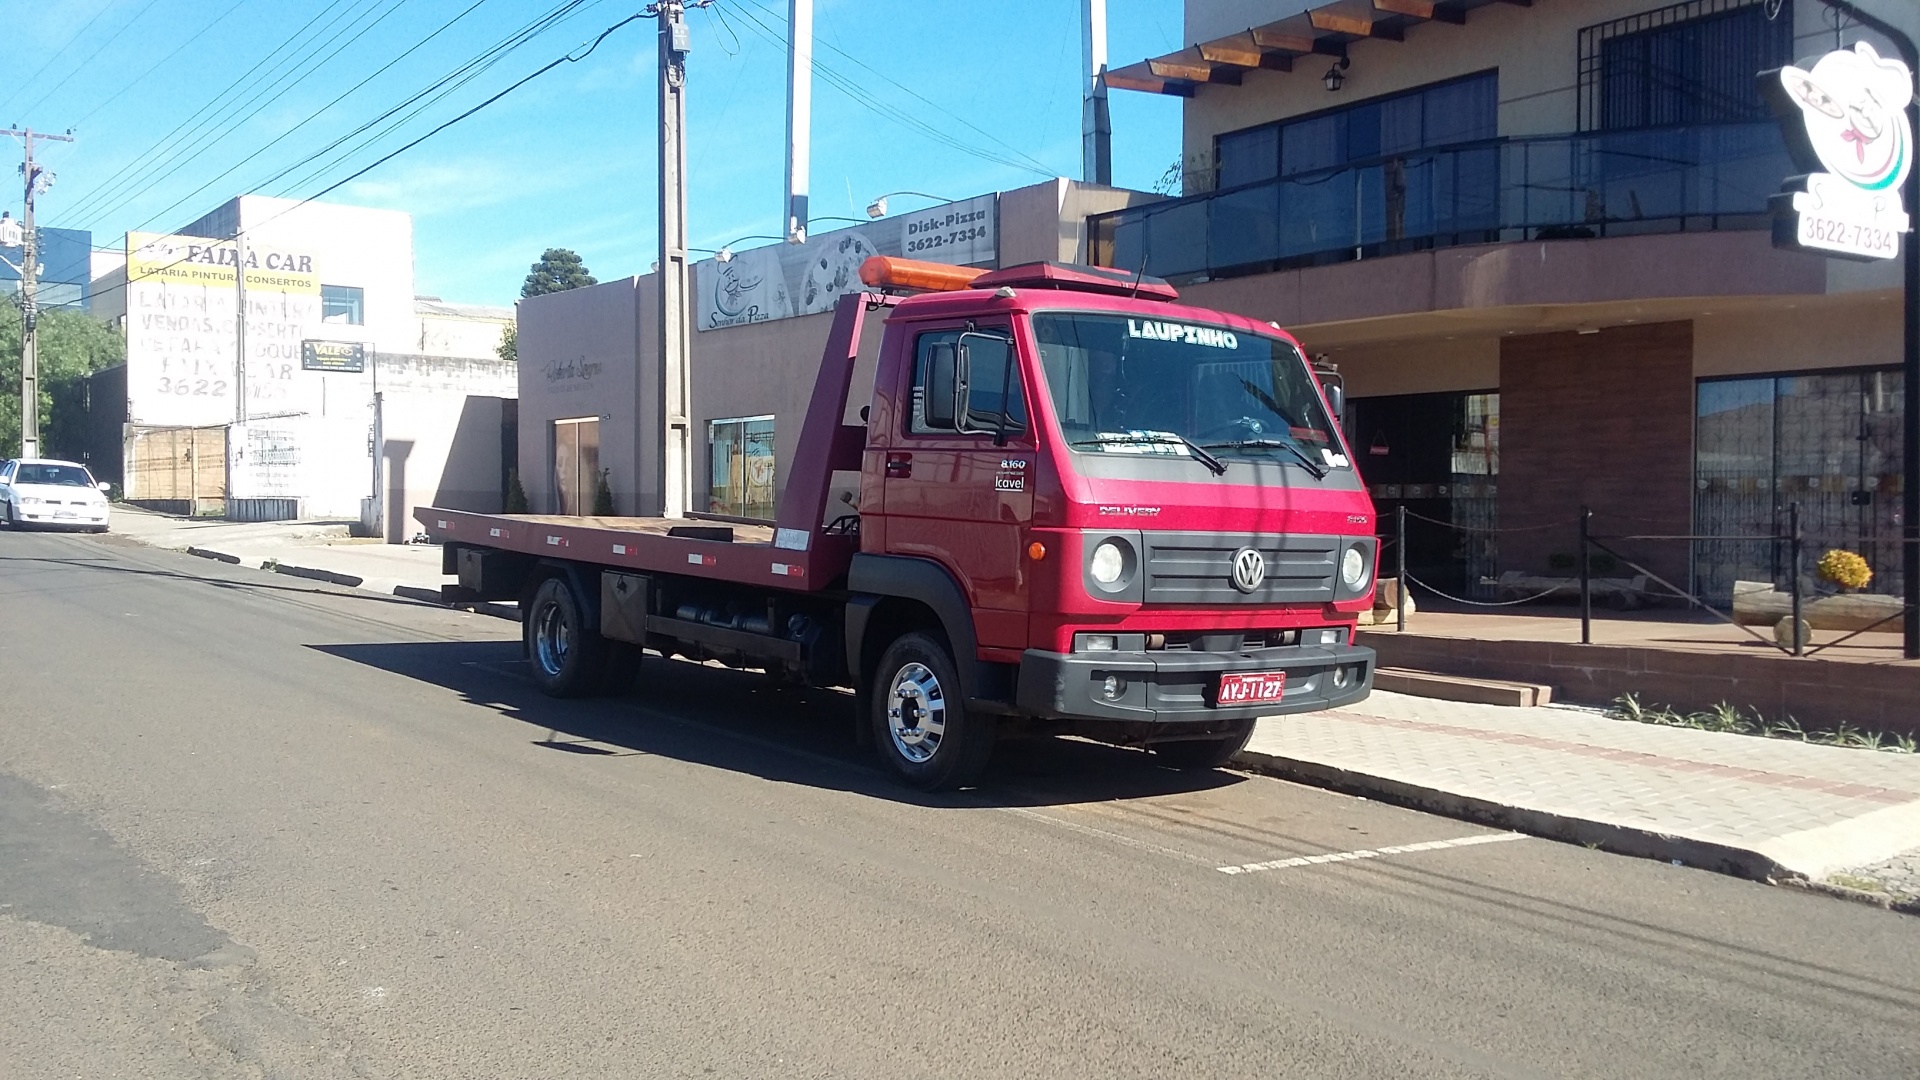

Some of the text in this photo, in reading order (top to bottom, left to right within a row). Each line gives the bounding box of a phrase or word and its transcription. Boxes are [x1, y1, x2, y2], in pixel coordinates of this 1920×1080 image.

[908, 210, 986, 235] Disk-Pizza
[1806, 217, 1892, 251] 3622-7334
[908, 226, 987, 252] 3622-7334
[187, 245, 259, 269] FAIXA
[265, 253, 313, 273] CAR
[140, 266, 188, 278] LATARIA
[246, 275, 312, 288] CONSERTOS
[747, 305, 770, 324] Pizza
[1128, 319, 1238, 350] LAUPINHO
[156, 377, 228, 398] 3622
[1099, 506, 1161, 516] DELIVERY
